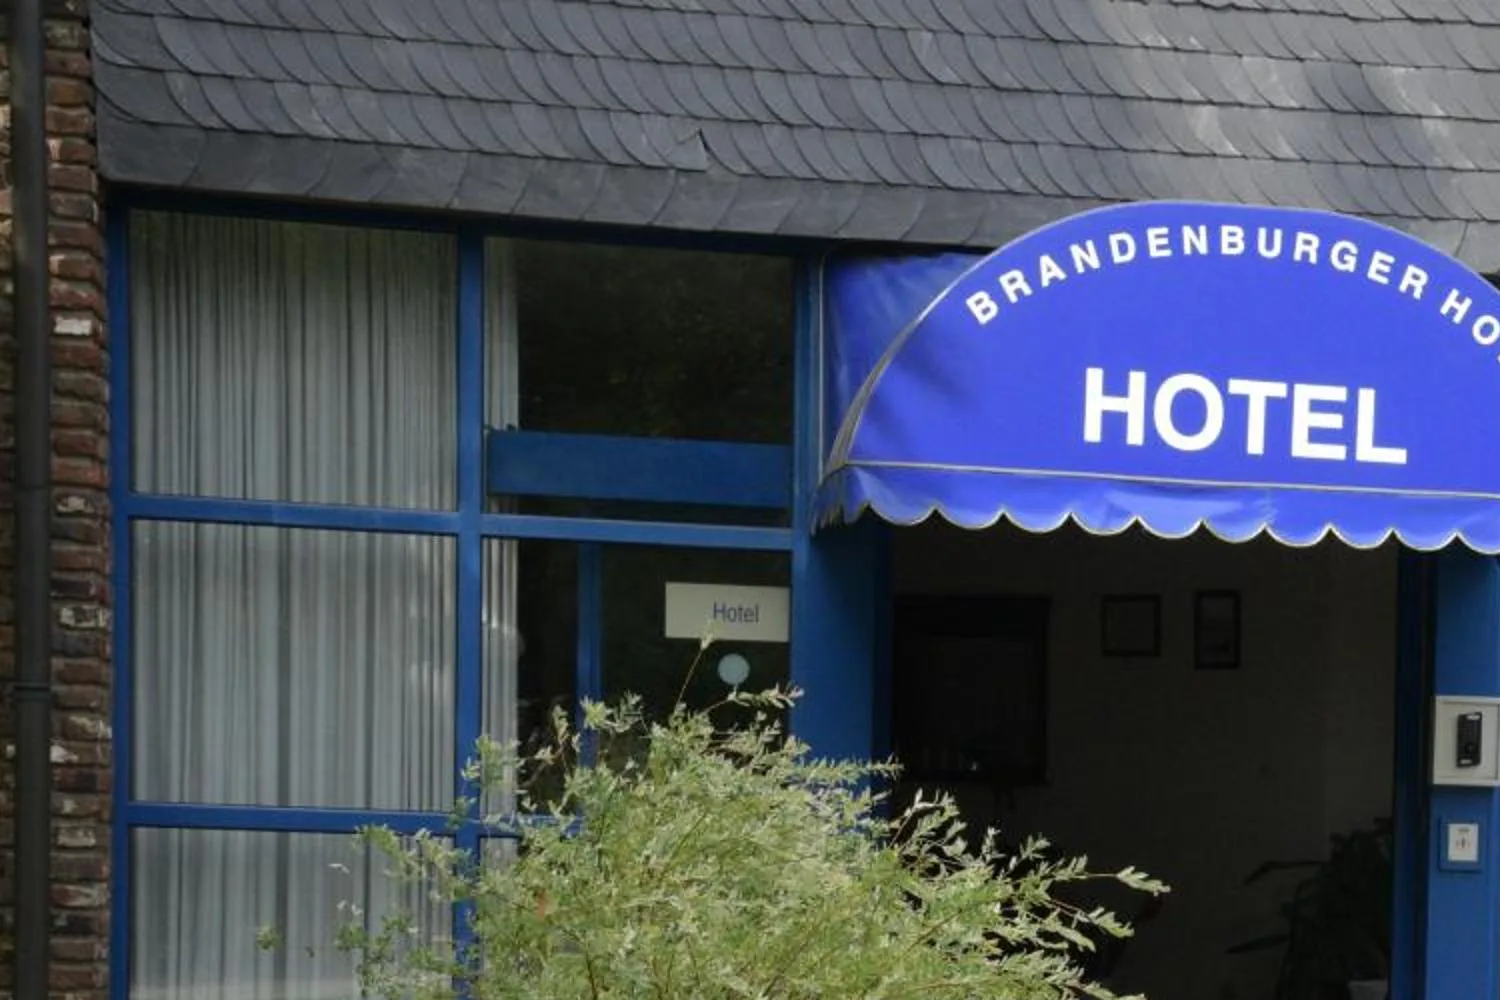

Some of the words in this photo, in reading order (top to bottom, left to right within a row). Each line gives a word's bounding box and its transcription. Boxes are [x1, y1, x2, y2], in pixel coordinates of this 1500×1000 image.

[965, 224, 1429, 325] BRANDENBURGER
[1083, 367, 1408, 465] HOTEL
[712, 602, 760, 624] Hotel
